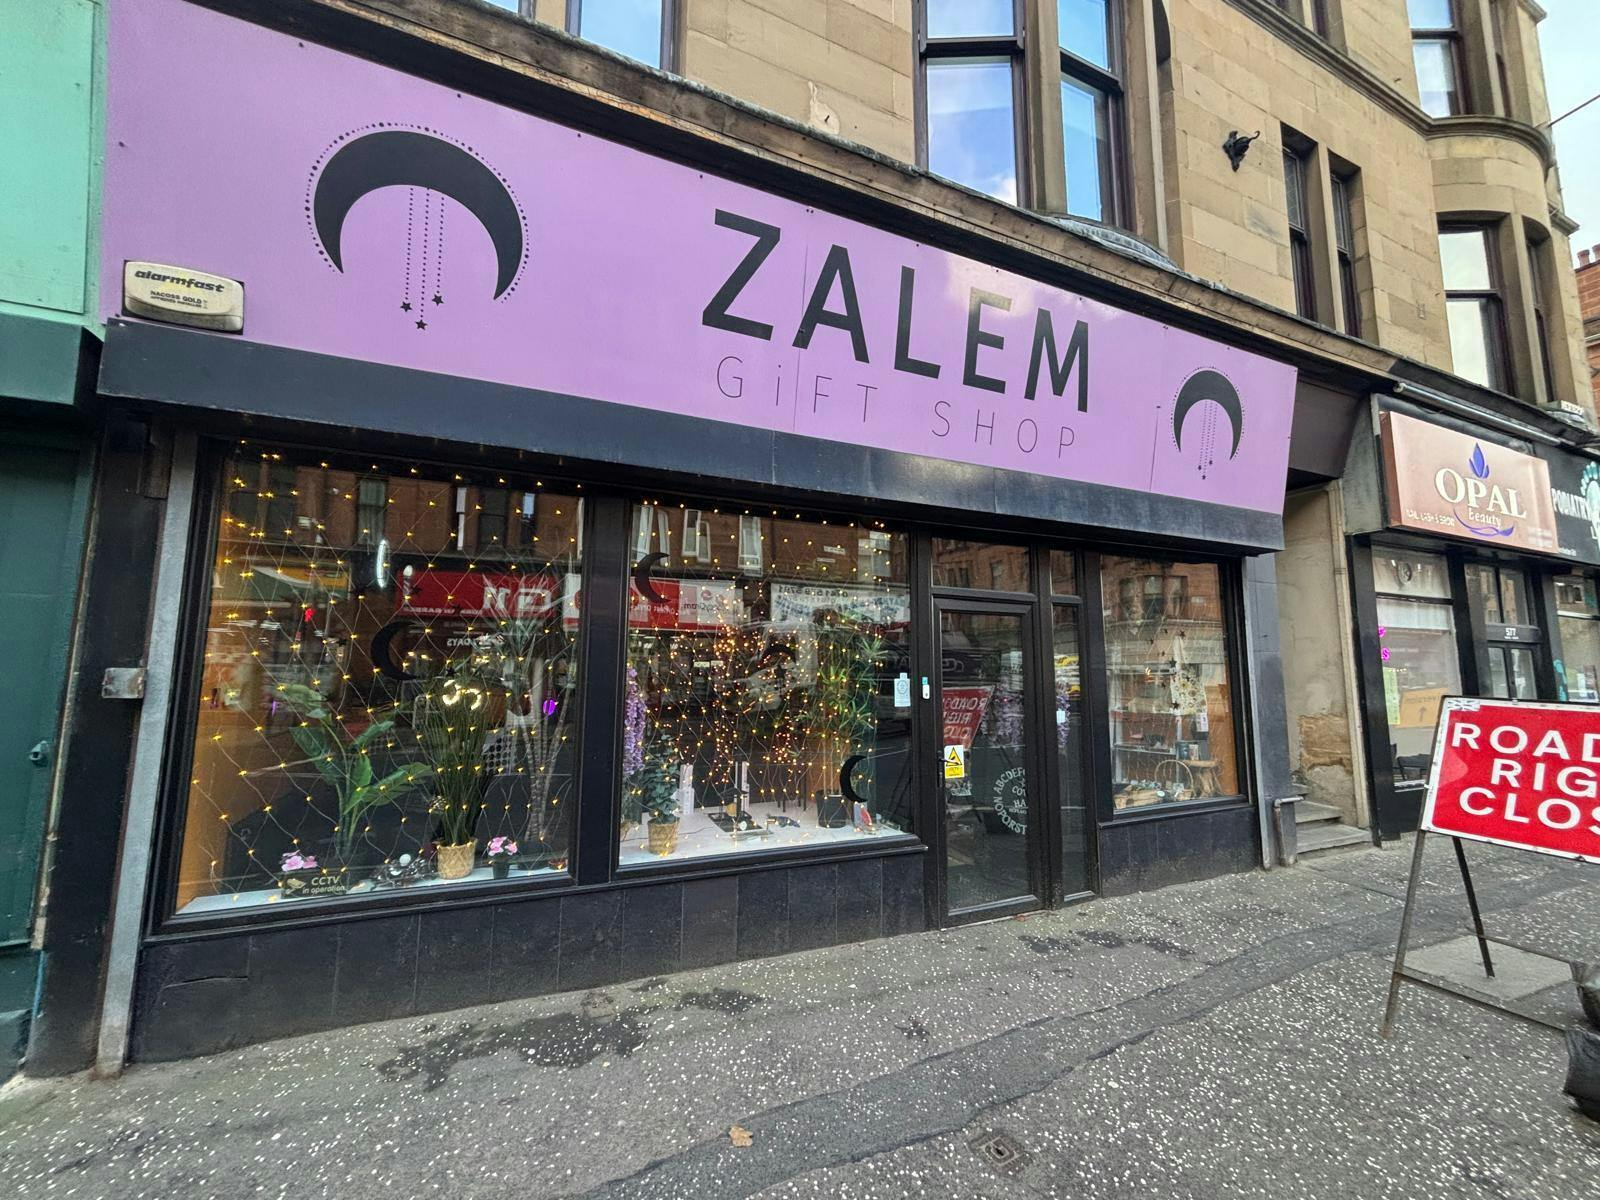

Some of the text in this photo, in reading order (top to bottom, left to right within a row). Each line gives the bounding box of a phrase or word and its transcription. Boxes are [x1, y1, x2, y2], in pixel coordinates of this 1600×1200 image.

[134, 270, 225, 293] alarmfast
[150, 290, 202, 304] NACOSS GOLD
[702, 208, 1089, 413] ZALEM
[931, 400, 1075, 459] SHOP
[1434, 467, 1527, 519] OPAL
[1468, 507, 1502, 527] beauty
[1451, 722, 1600, 763] ROAD
[1490, 758, 1597, 798] RIG
[311, 875, 341, 886] CCTV
[311, 885, 346, 896] operation
